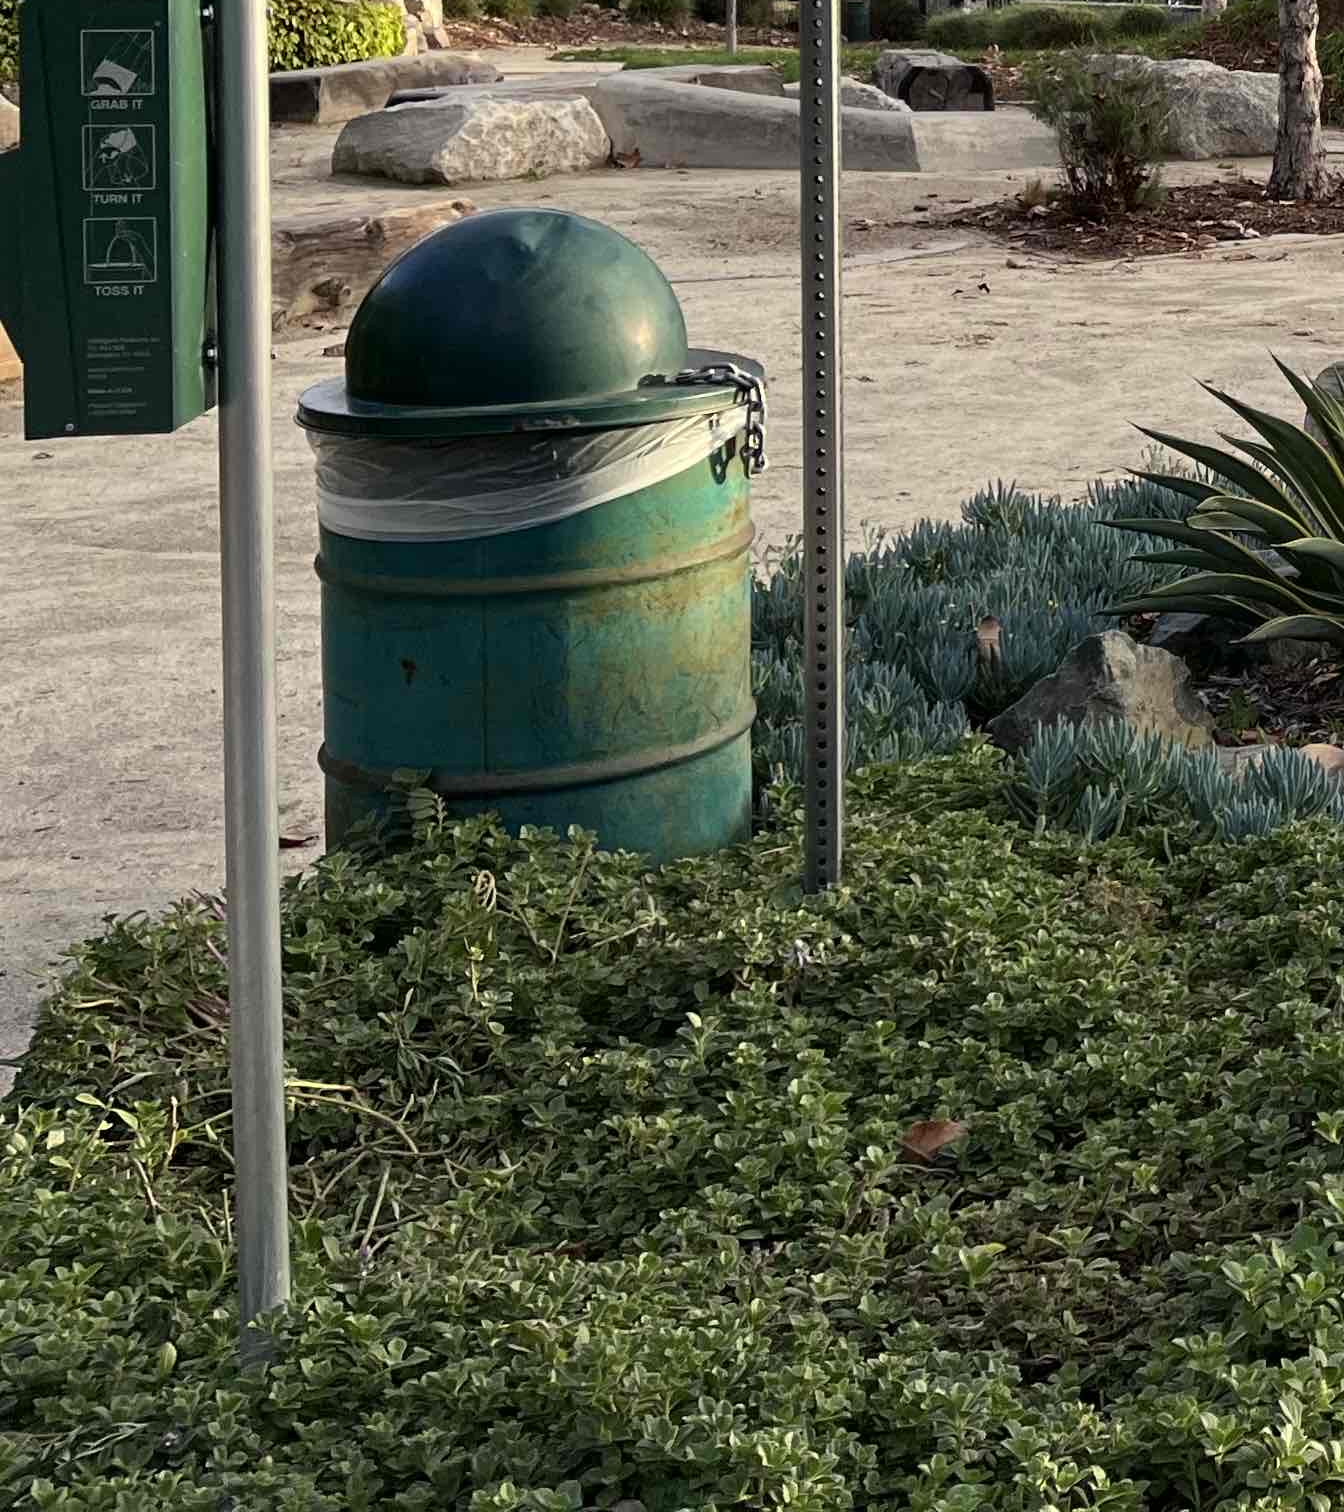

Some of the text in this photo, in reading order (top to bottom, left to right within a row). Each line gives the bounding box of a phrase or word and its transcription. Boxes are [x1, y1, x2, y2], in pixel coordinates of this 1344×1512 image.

[91, 100, 144, 110] GRAB IT
[93, 194, 143, 204] TURN IT
[94, 286, 144, 296] TOSS IT
